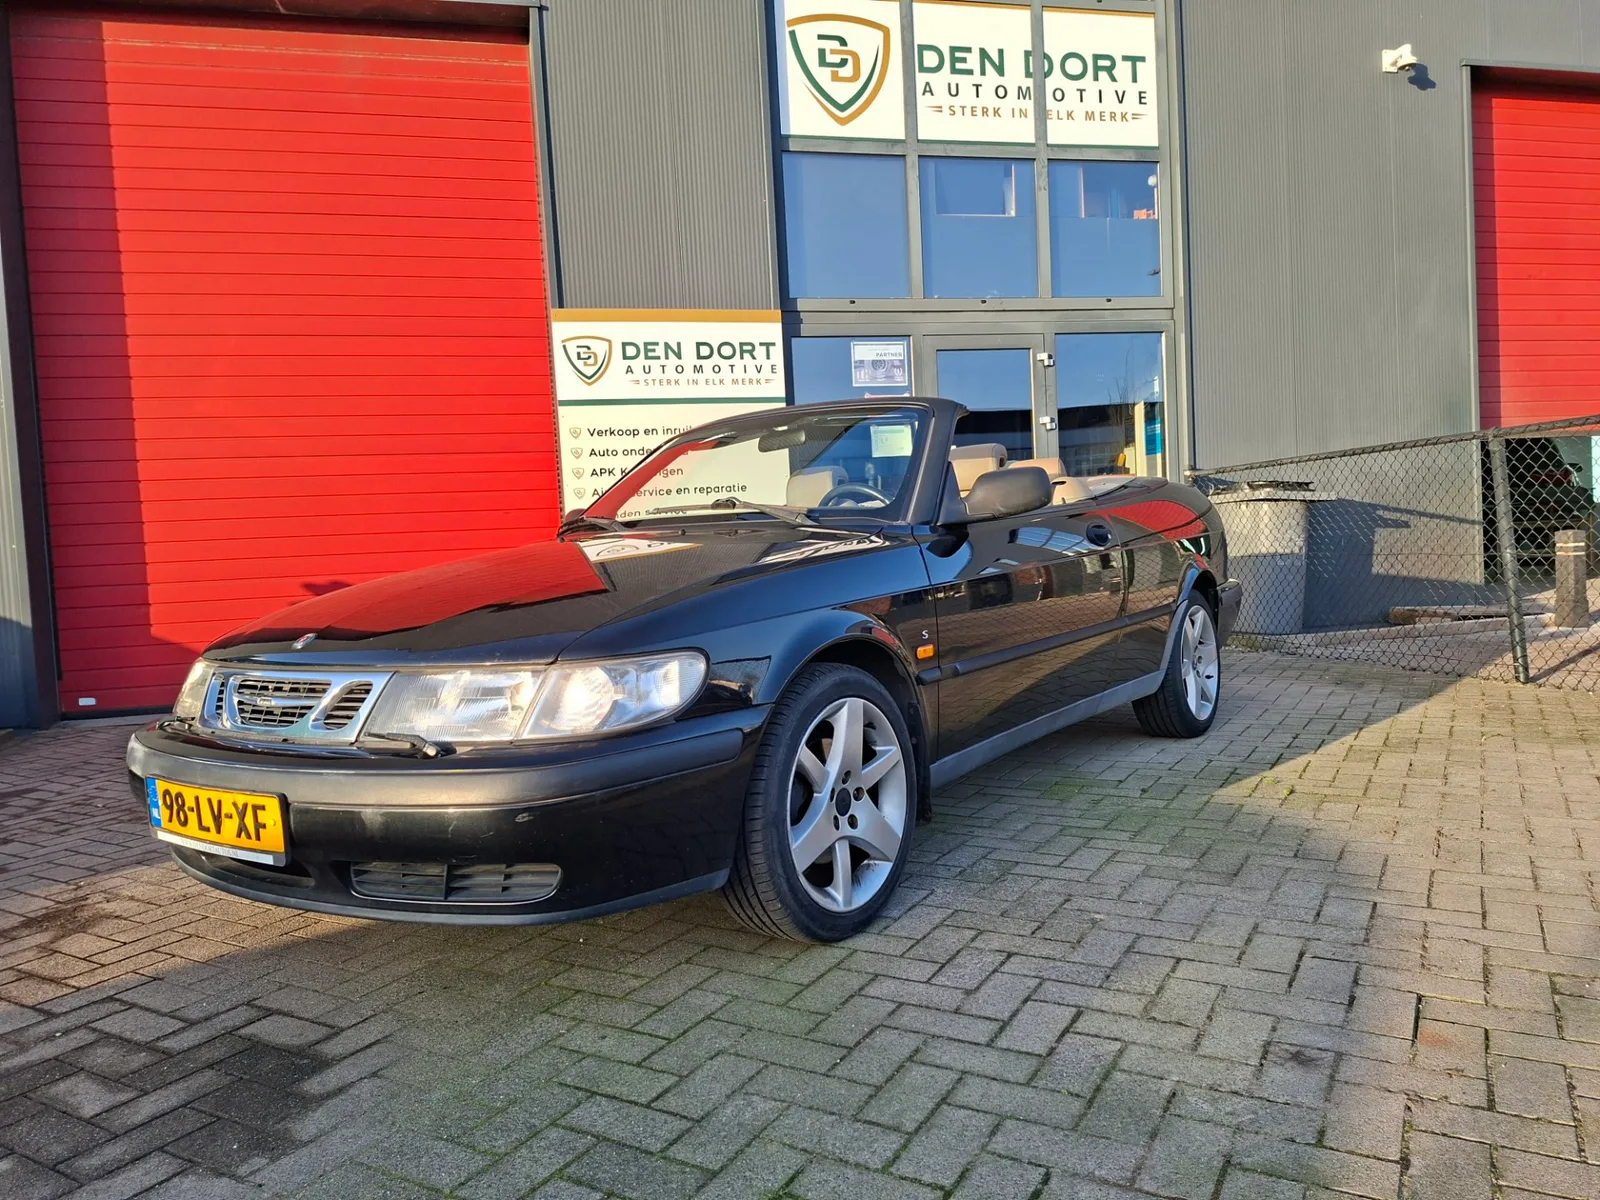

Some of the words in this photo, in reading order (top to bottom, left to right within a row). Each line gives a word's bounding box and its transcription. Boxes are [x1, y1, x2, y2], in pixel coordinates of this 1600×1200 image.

[917, 44, 1005, 77] DEN
[1024, 50, 1146, 83] DORT
[922, 81, 1147, 105] AUTOMOTIVE
[948, 105, 1002, 118] STERK
[1011, 107, 1028, 119] IN
[1045, 109, 1075, 121] ELK
[1085, 110, 1129, 122] MERK
[621, 341, 682, 361] DEN
[695, 341, 776, 361] DORT
[625, 364, 778, 375] AUTOMOTIVE
[643, 378, 681, 387] STERK
[686, 378, 699, 386] IN
[705, 378, 725, 386] ELK
[731, 377, 762, 386] MERK
[587, 427, 640, 438] Verkoop
[643, 428, 659, 436] en
[589, 448, 619, 457] Auto
[590, 467, 616, 477] APK
[676, 487, 690, 495] en
[694, 482, 747, 496] reparatie
[922, 629, 929, 639] S
[162, 788, 267, 842] 98-LV-XF
